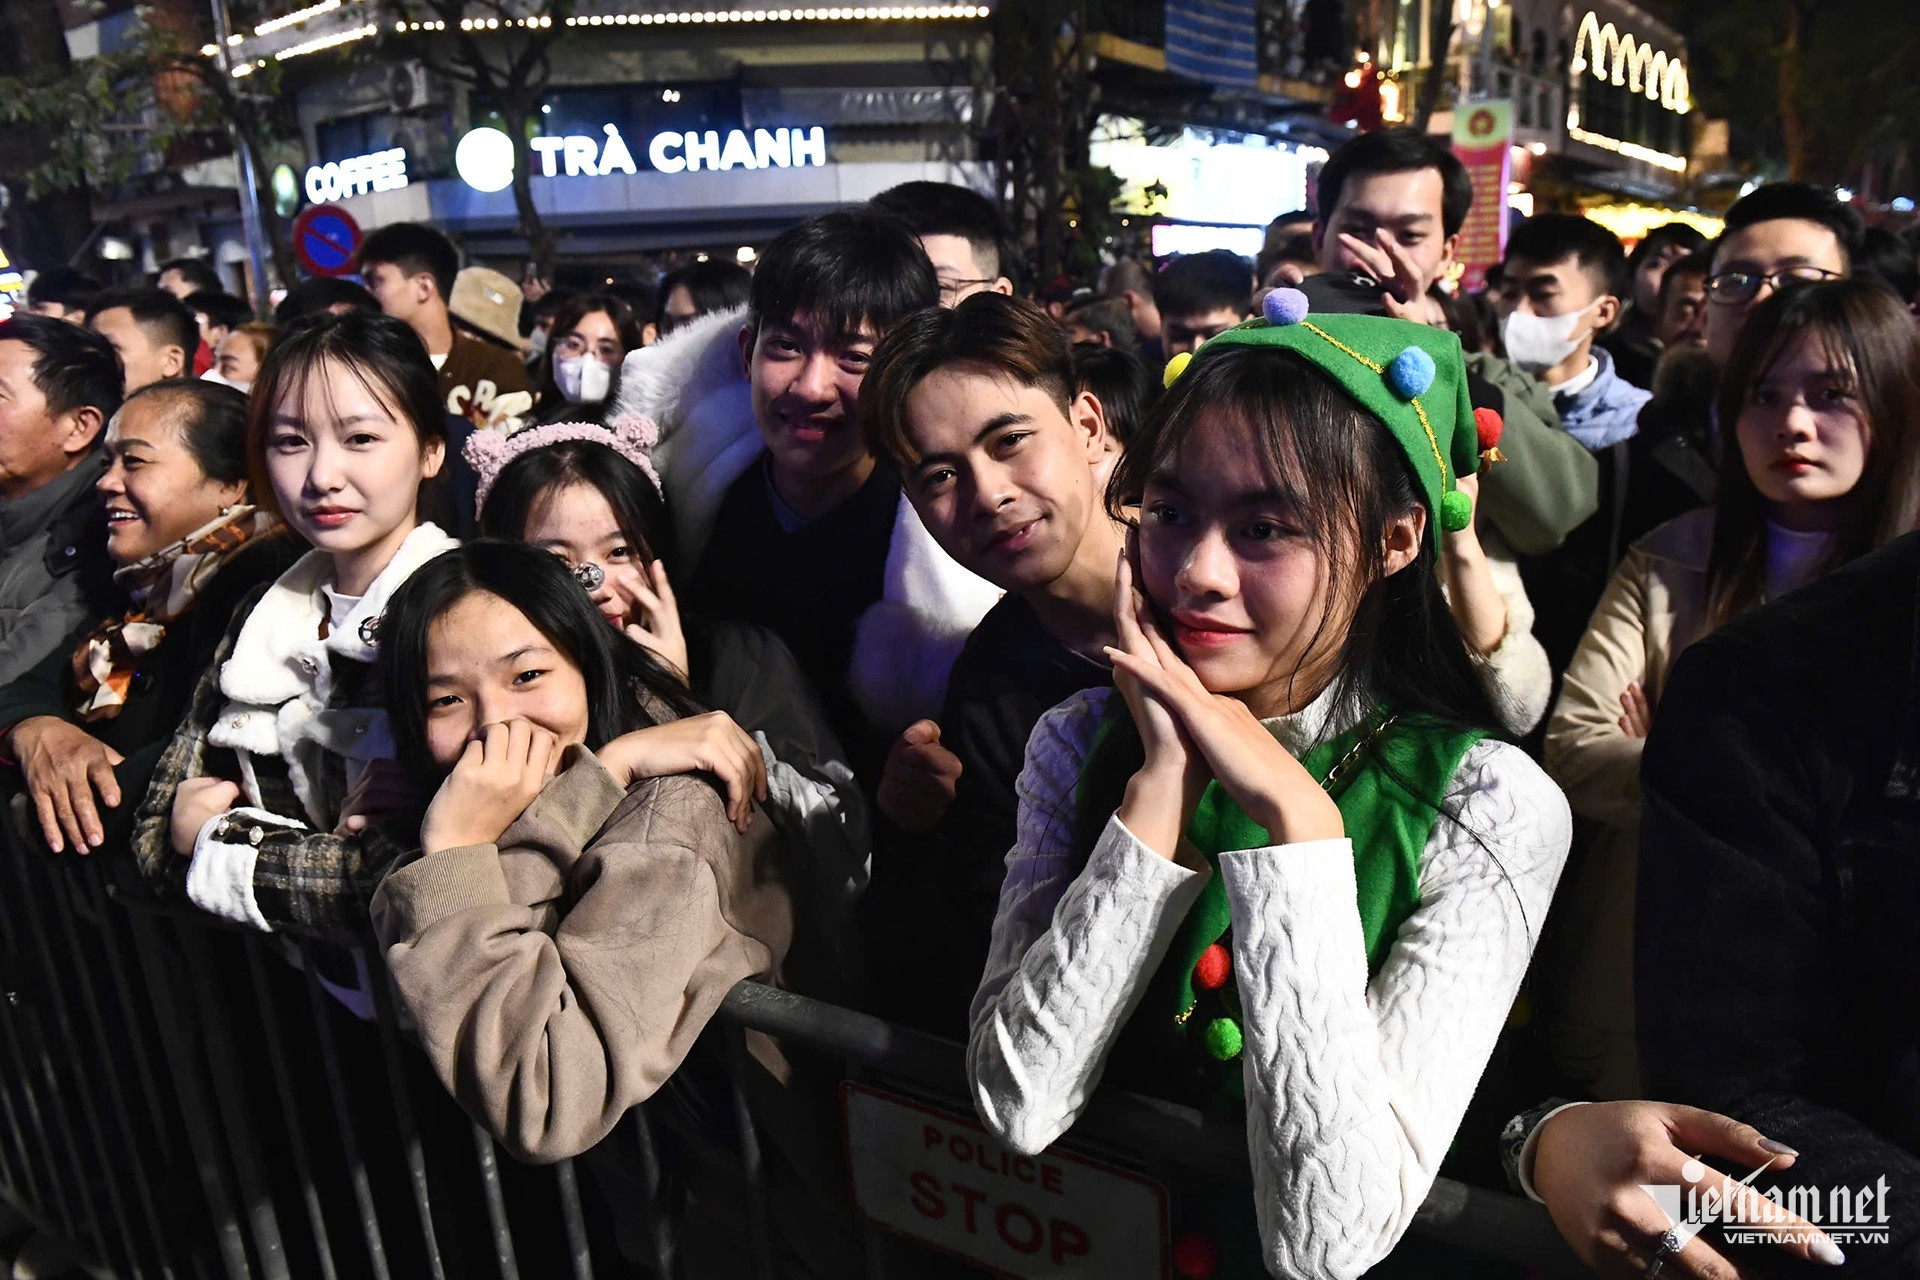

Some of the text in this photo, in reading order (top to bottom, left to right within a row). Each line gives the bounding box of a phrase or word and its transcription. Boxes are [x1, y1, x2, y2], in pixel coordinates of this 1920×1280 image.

[305, 147, 408, 205] COFFEE
[530, 123, 826, 177] TRÀ CHANH
[923, 1125, 1064, 1195] POLICE
[909, 1170, 1091, 1266] STOP
